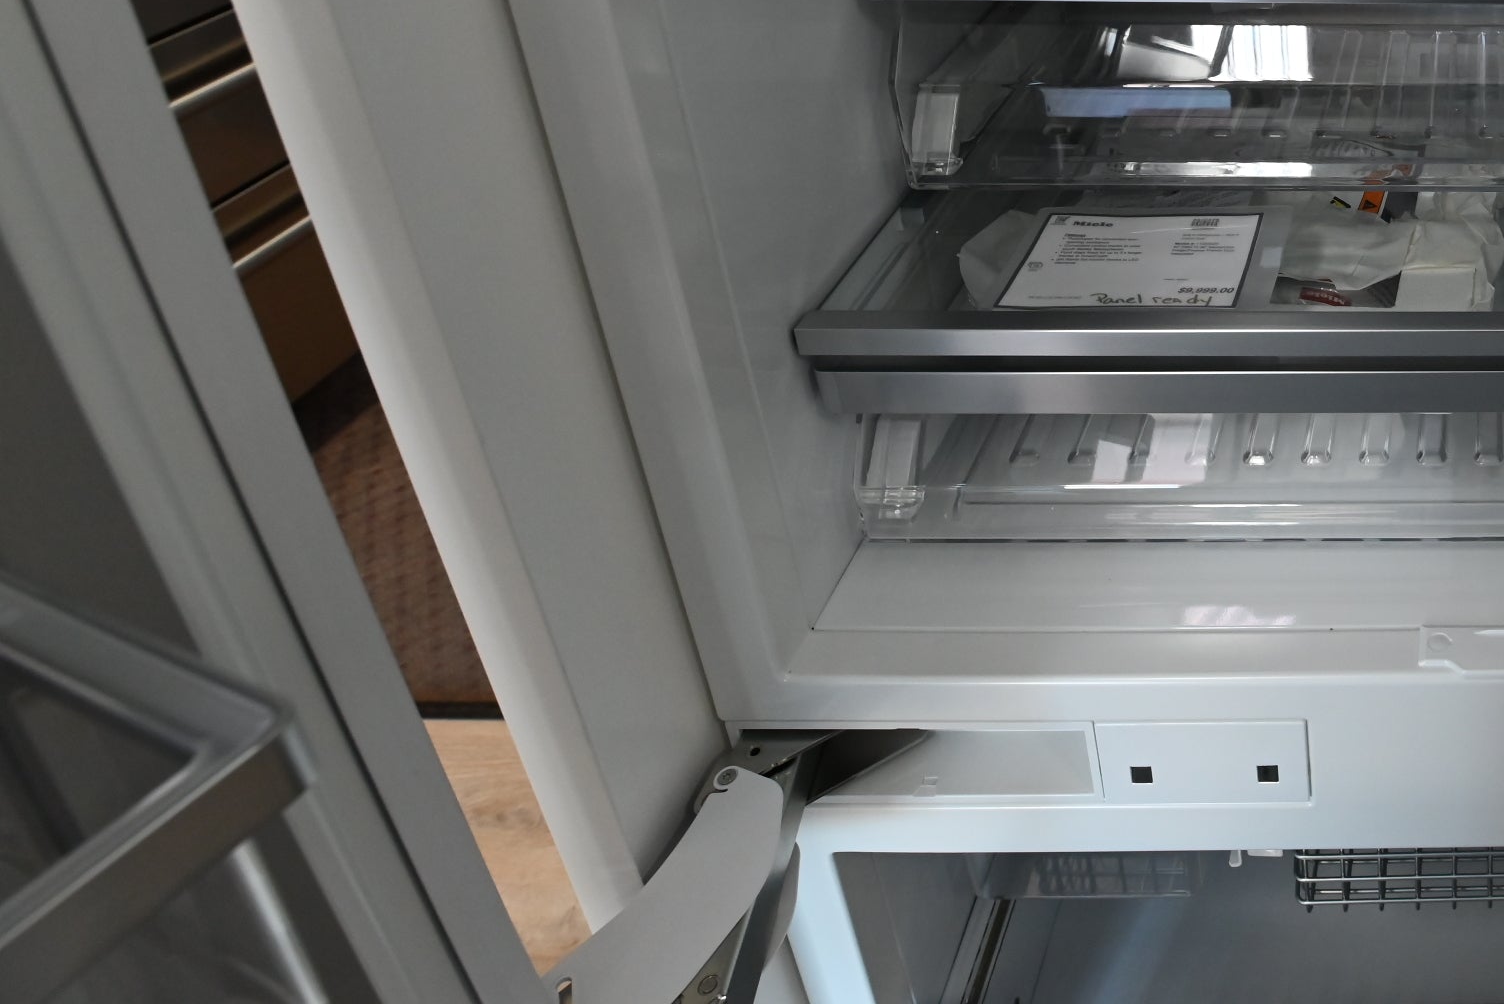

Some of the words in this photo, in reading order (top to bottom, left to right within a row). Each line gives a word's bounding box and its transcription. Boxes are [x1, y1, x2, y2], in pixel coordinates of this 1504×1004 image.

[1073, 220, 1114, 228] Miele
[1177, 287, 1236, 295] $9,999.00
[1090, 292, 1144, 305] Panel
[1151, 294, 1213, 307] ready
